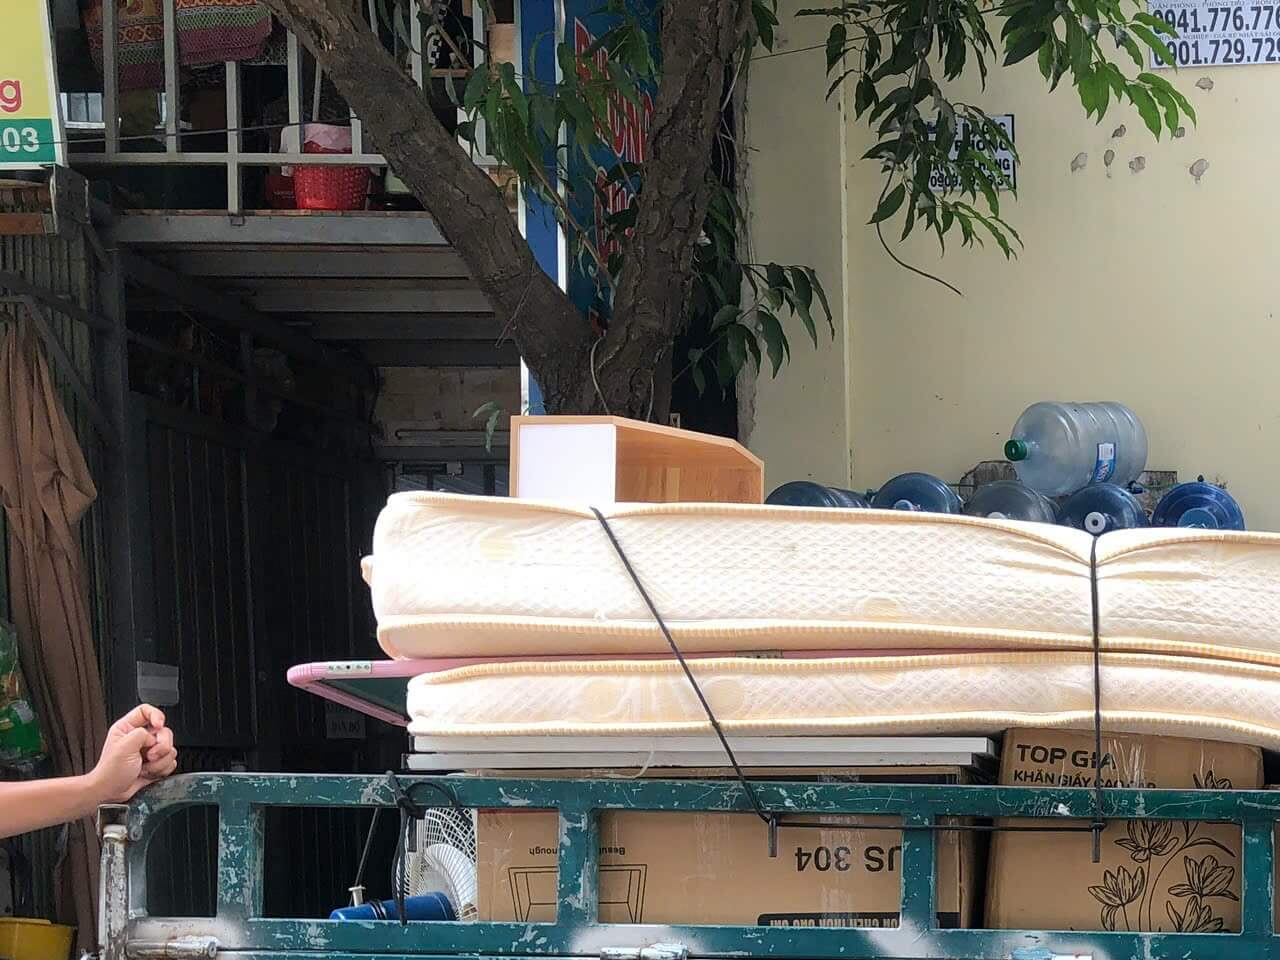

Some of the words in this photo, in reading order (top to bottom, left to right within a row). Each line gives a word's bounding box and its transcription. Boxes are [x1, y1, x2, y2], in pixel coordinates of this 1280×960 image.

[1017, 744, 1067, 765] TOP
[1014, 770, 1055, 785] KHĂN
[1058, 771, 1092, 788] GIẤY
[795, 846, 851, 871] 304
